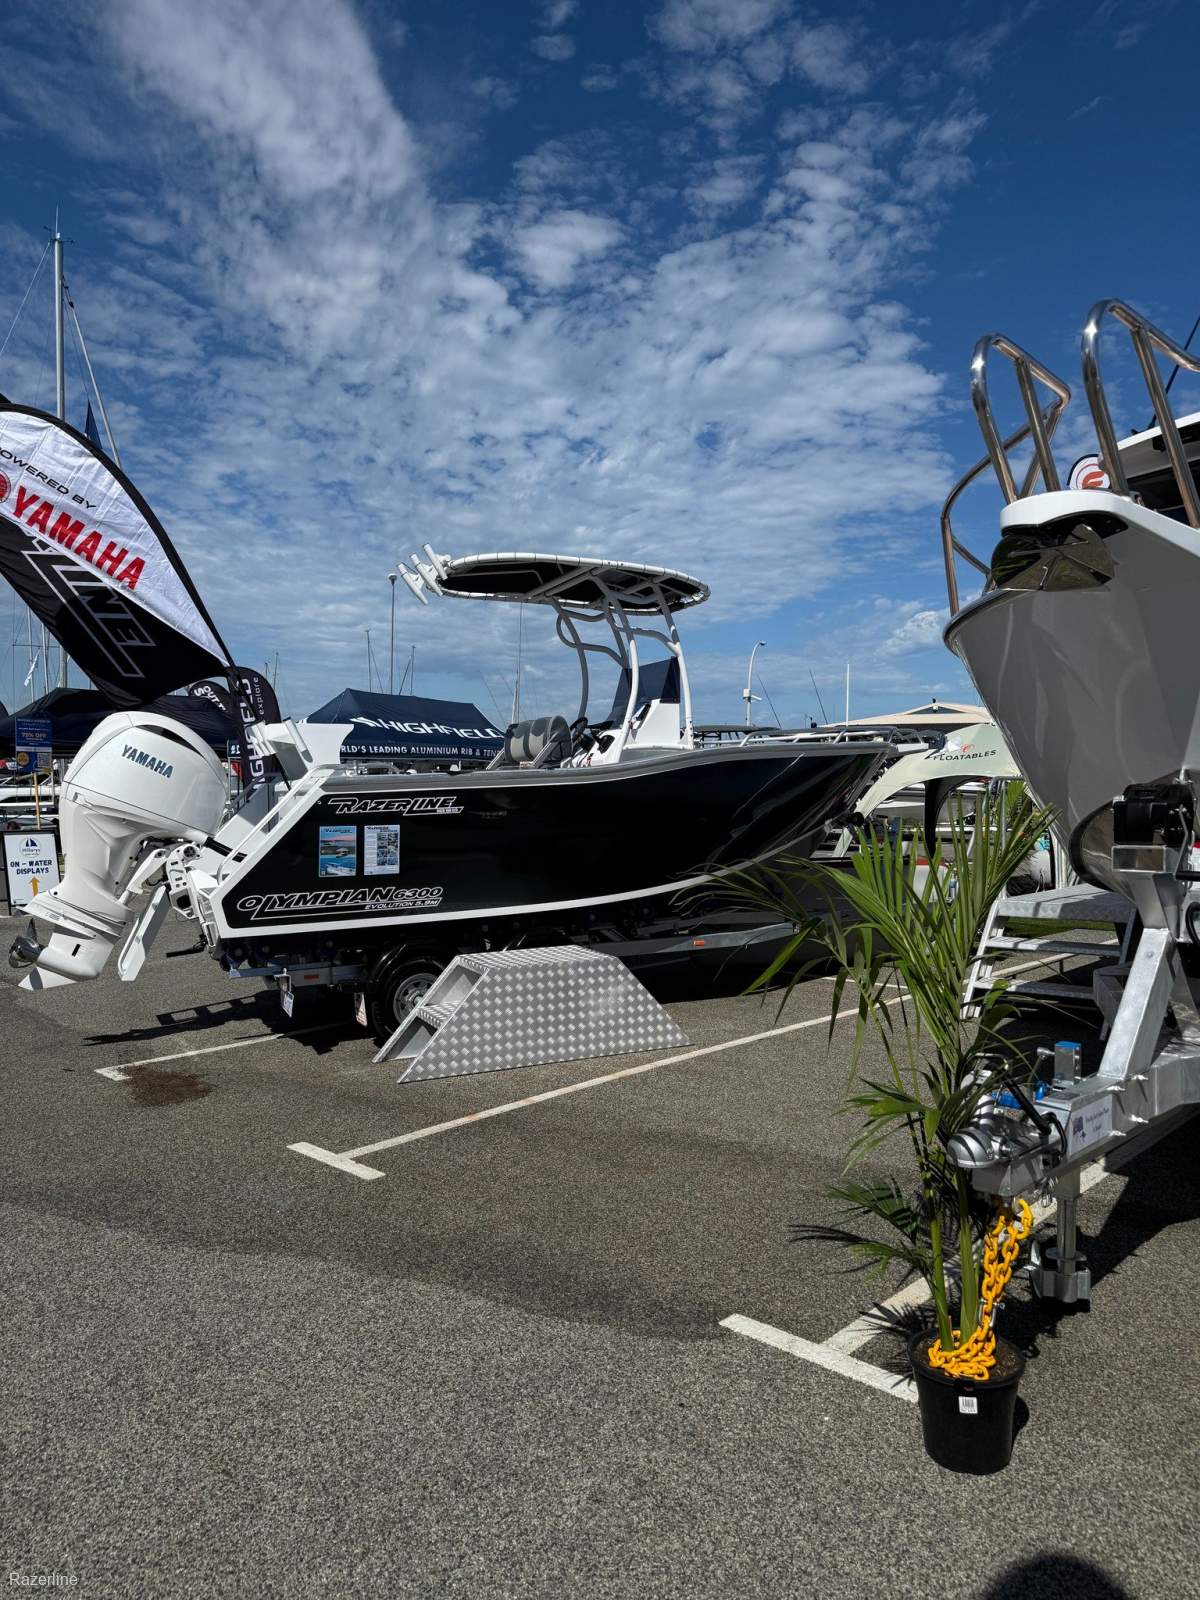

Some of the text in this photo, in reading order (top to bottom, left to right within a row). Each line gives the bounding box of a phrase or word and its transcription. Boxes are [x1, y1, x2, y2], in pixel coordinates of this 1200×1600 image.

[0, 447, 96, 509] OWERED BY
[12, 485, 146, 590] YAMAHA
[253, 676, 265, 716] explore
[376, 718, 505, 739] HIGHFIELD
[121, 744, 174, 778] YAMAHA
[341, 744, 367, 754] RLD'S
[369, 745, 408, 754] LEADING
[410, 746, 459, 756] ALUMINIUM
[460, 748, 473, 756] RIB
[16, 867, 50, 875] DISPLAYS
[236, 886, 444, 920] OLYMPIAN 6300
[364, 900, 414, 910] EVOLUTION
